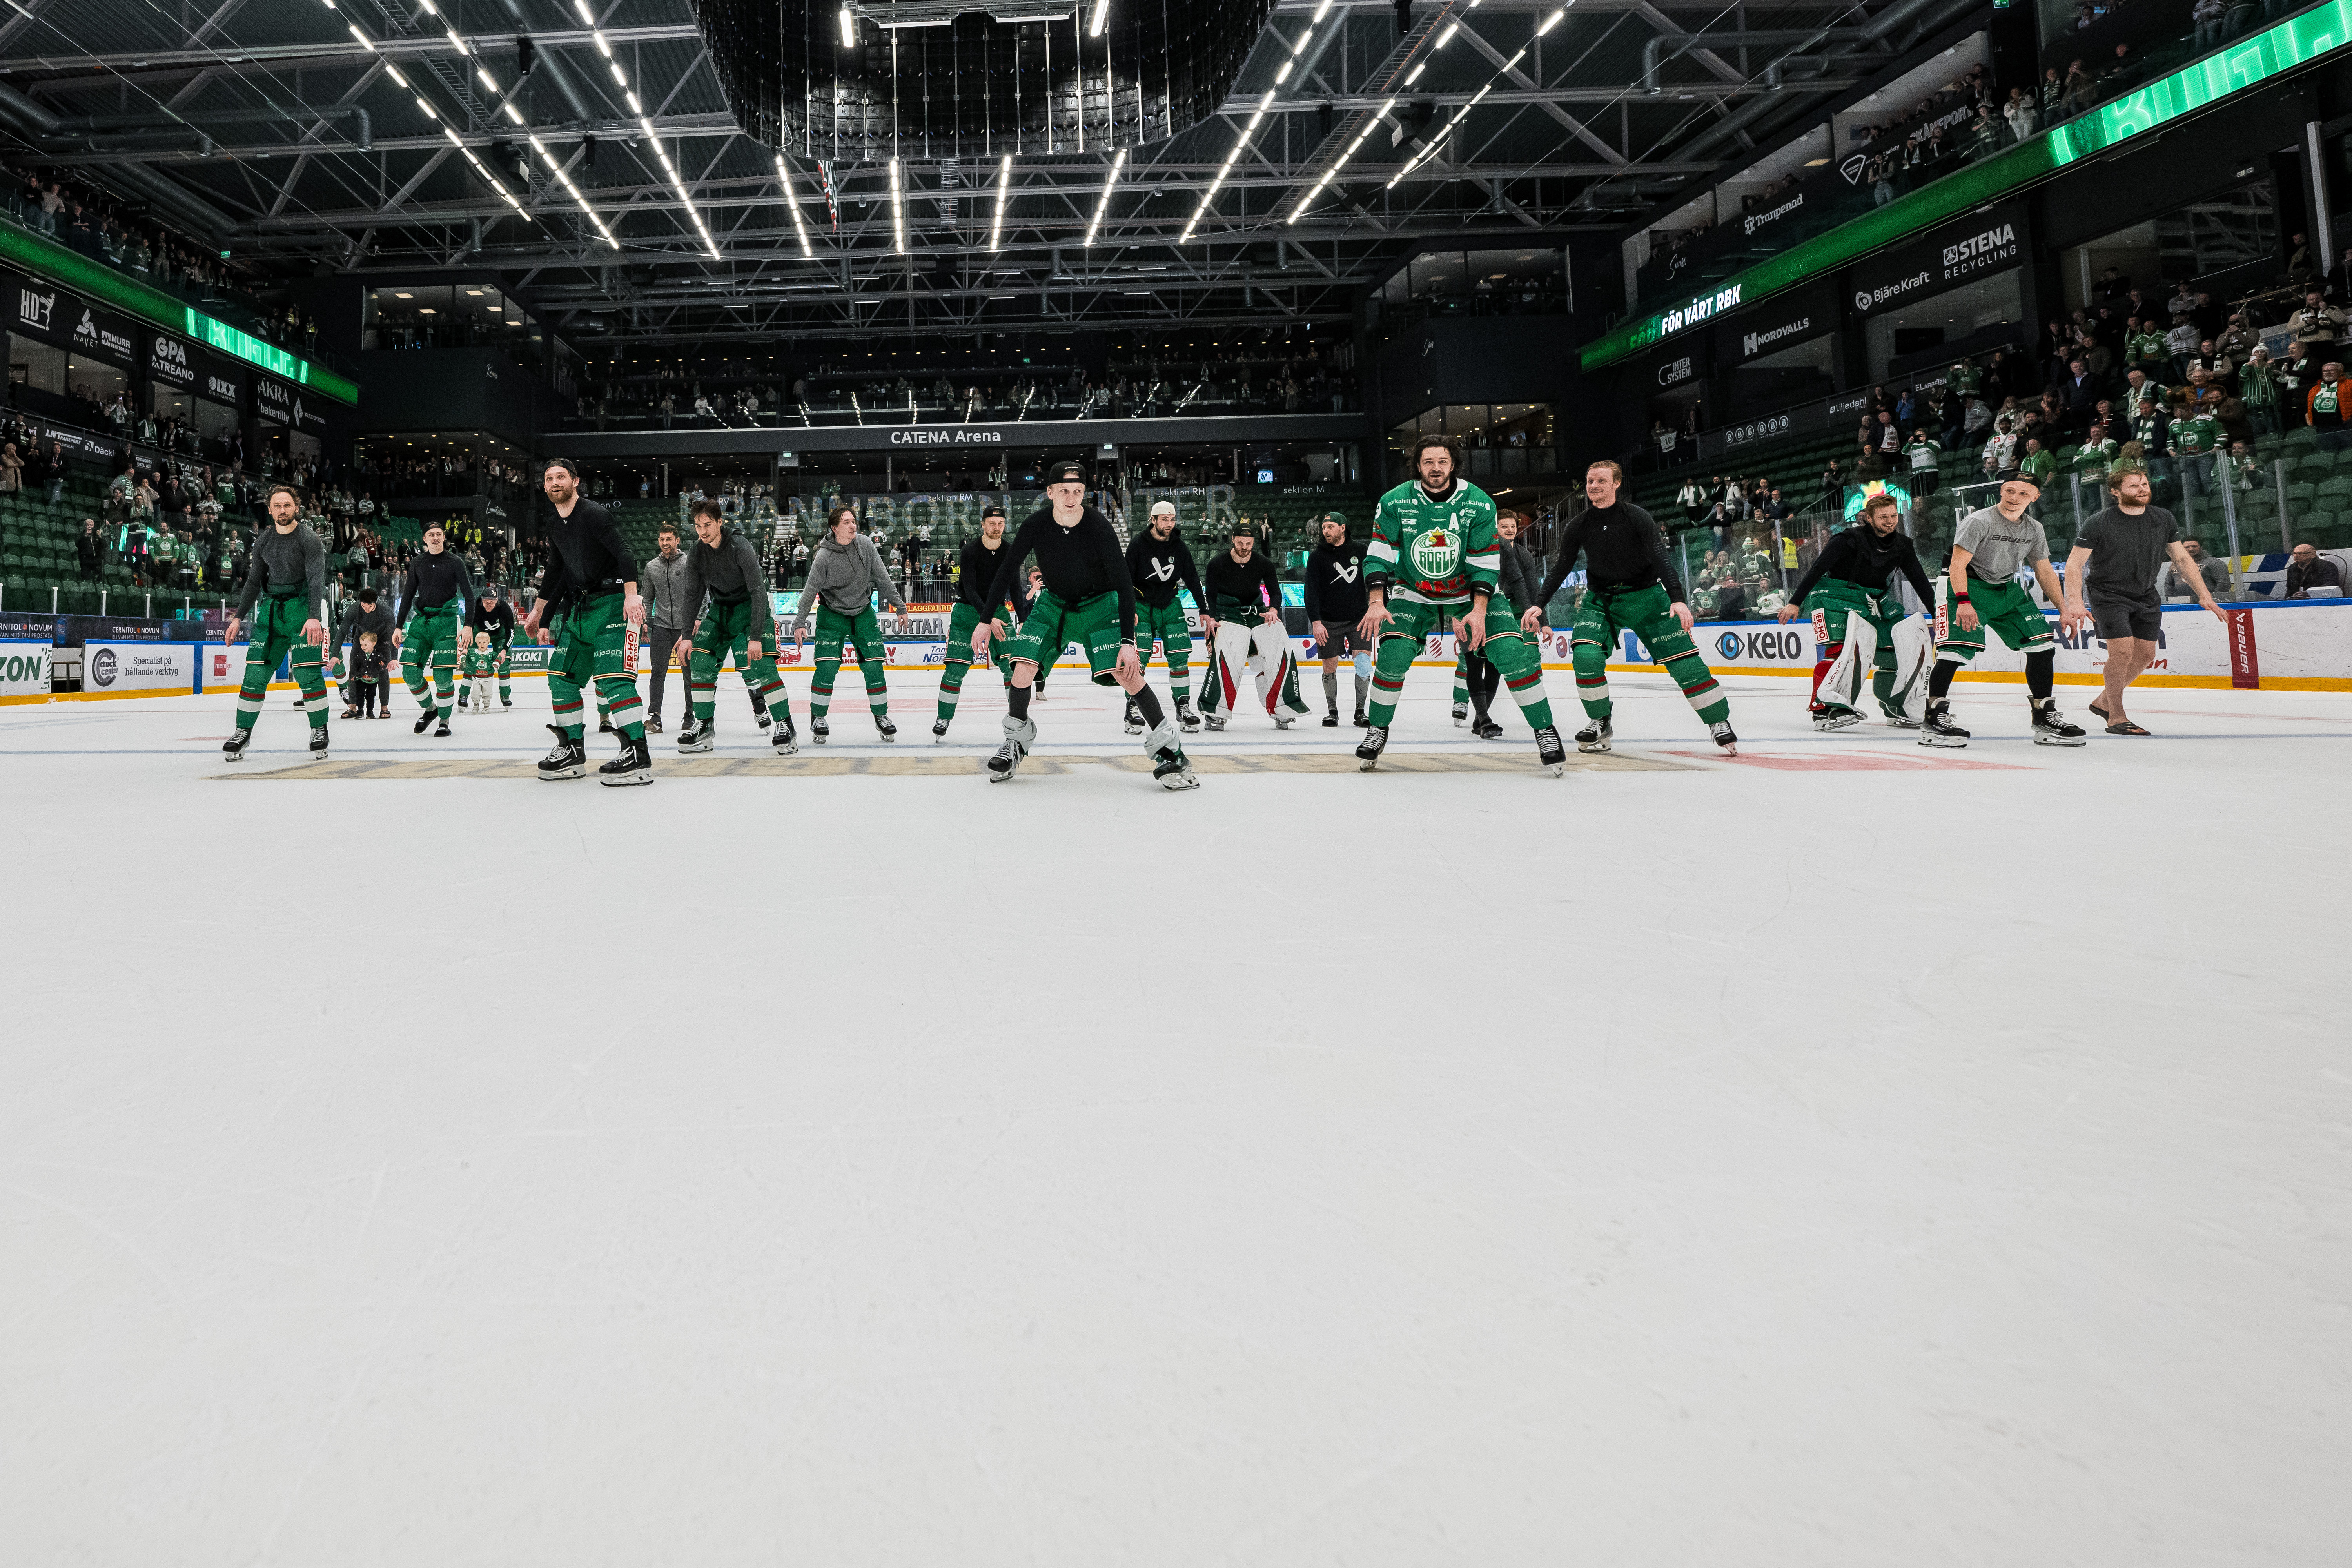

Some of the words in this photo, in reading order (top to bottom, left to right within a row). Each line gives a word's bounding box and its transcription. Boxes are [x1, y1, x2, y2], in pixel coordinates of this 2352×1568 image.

[1959, 223, 2015, 260] STENA
[1945, 245, 2016, 279] RECYCLING
[20, 289, 40, 321] HD
[1662, 309, 1682, 336] FÖR
[1684, 298, 1713, 326] VÅRT
[1715, 284, 1741, 312] RBK
[1757, 318, 1809, 345] NORDVALLS
[74, 333, 98, 348] NAVET
[111, 334, 131, 348] MURR
[156, 337, 186, 365] GPA
[1673, 357, 1690, 372] INTER
[1667, 366, 1691, 384] SYSTEM
[1836, 397, 1866, 412] Liljedahl
[260, 402, 289, 425] bakertilly
[891, 431, 950, 444] CATENA
[955, 430, 1001, 443] Arena
[1160, 488, 1190, 497] sektion
[1283, 485, 1313, 494] sektion
[1448, 513, 1460, 530] A
[1419, 549, 1455, 573] RÖGLE
[1815, 613, 1826, 639] ER-HO
[506, 629, 515, 647] BAUER
[100, 659, 117, 667] chuck
[133, 656, 163, 666] Specialist
[164, 655, 171, 666] på
[215, 660, 232, 670] menigo
[101, 667, 118, 675] center
[125, 667, 153, 676] hållande
[155, 667, 178, 677] verktyg
[1923, 666, 1931, 690] BAUER
[1205, 671, 1214, 698] BAUER
